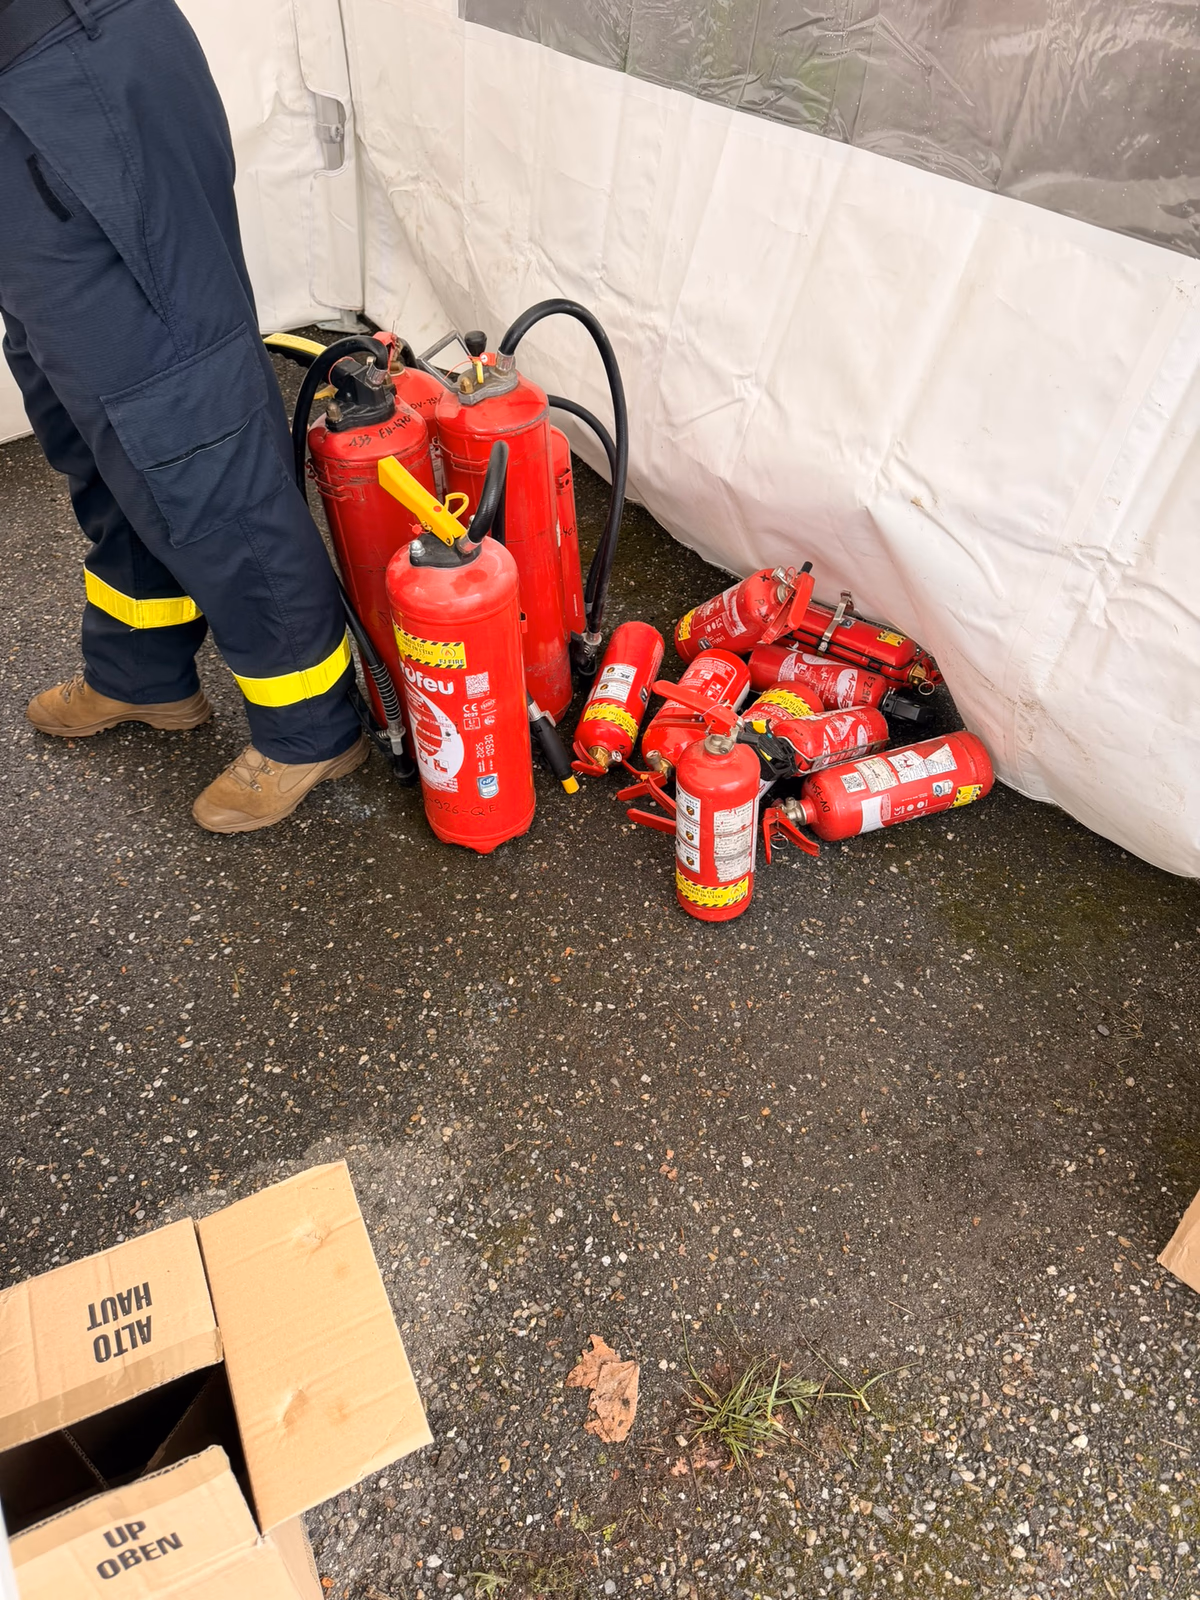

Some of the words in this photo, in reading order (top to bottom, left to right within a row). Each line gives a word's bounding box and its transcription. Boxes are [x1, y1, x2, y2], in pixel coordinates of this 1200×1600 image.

[462, 703, 478, 713] CE
[87, 1282, 153, 1332] HAUT
[93, 1315, 153, 1364] ALTO
[96, 1532, 184, 1580] OBEN
[103, 1520, 147, 1550] UP
